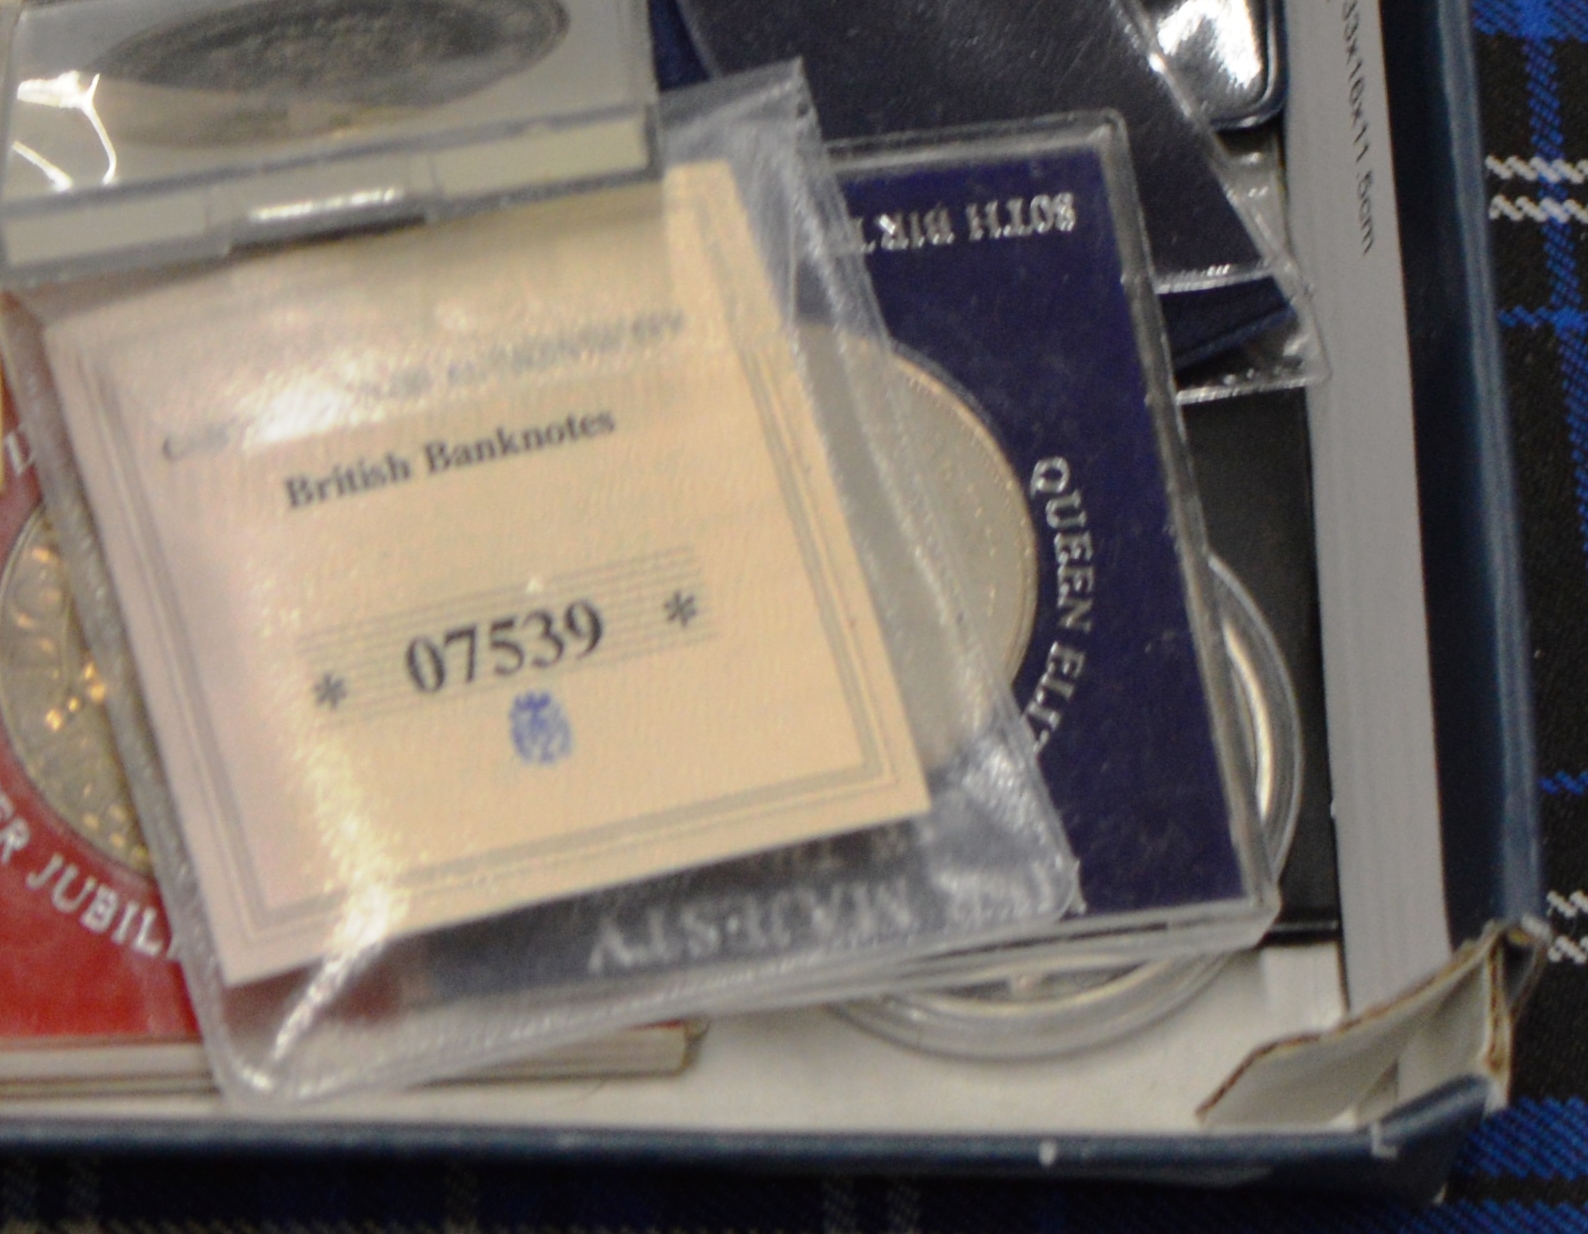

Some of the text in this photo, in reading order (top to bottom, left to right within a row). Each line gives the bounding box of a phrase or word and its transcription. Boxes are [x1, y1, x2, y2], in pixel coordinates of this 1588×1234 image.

[283, 407, 617, 511] British Banknotes
[1030, 455, 1096, 635] QUEEN
[403, 598, 606, 695] 07539
